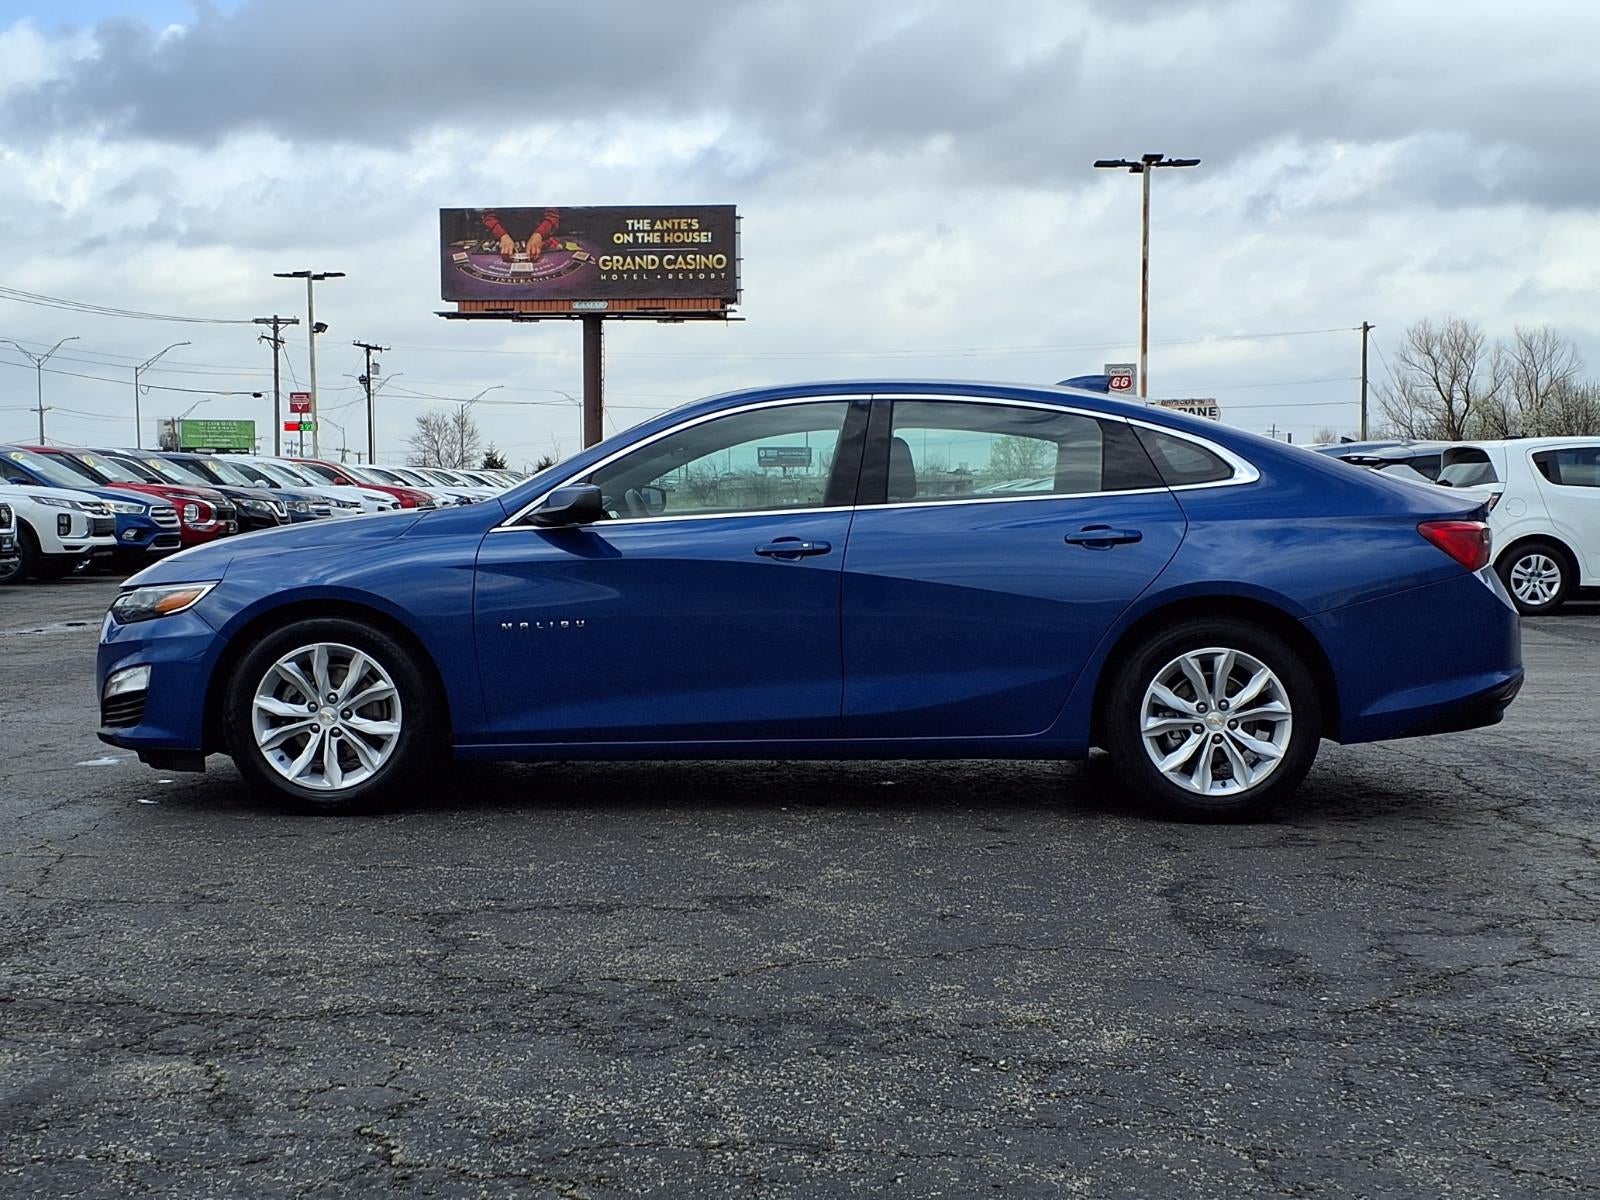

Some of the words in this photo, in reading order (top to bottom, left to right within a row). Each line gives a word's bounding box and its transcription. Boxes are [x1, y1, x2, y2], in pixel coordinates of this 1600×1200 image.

[626, 219, 651, 230] THE
[654, 218, 699, 230] ANTE'S
[613, 232, 634, 244] ON
[636, 232, 661, 243] THE
[664, 231, 712, 243] HOUSE!
[599, 254, 660, 270] GRAND
[662, 253, 727, 270] CASINO
[668, 272, 726, 280] RESORT
[1112, 376, 1129, 387] 66
[501, 620, 585, 630] MALIBU
